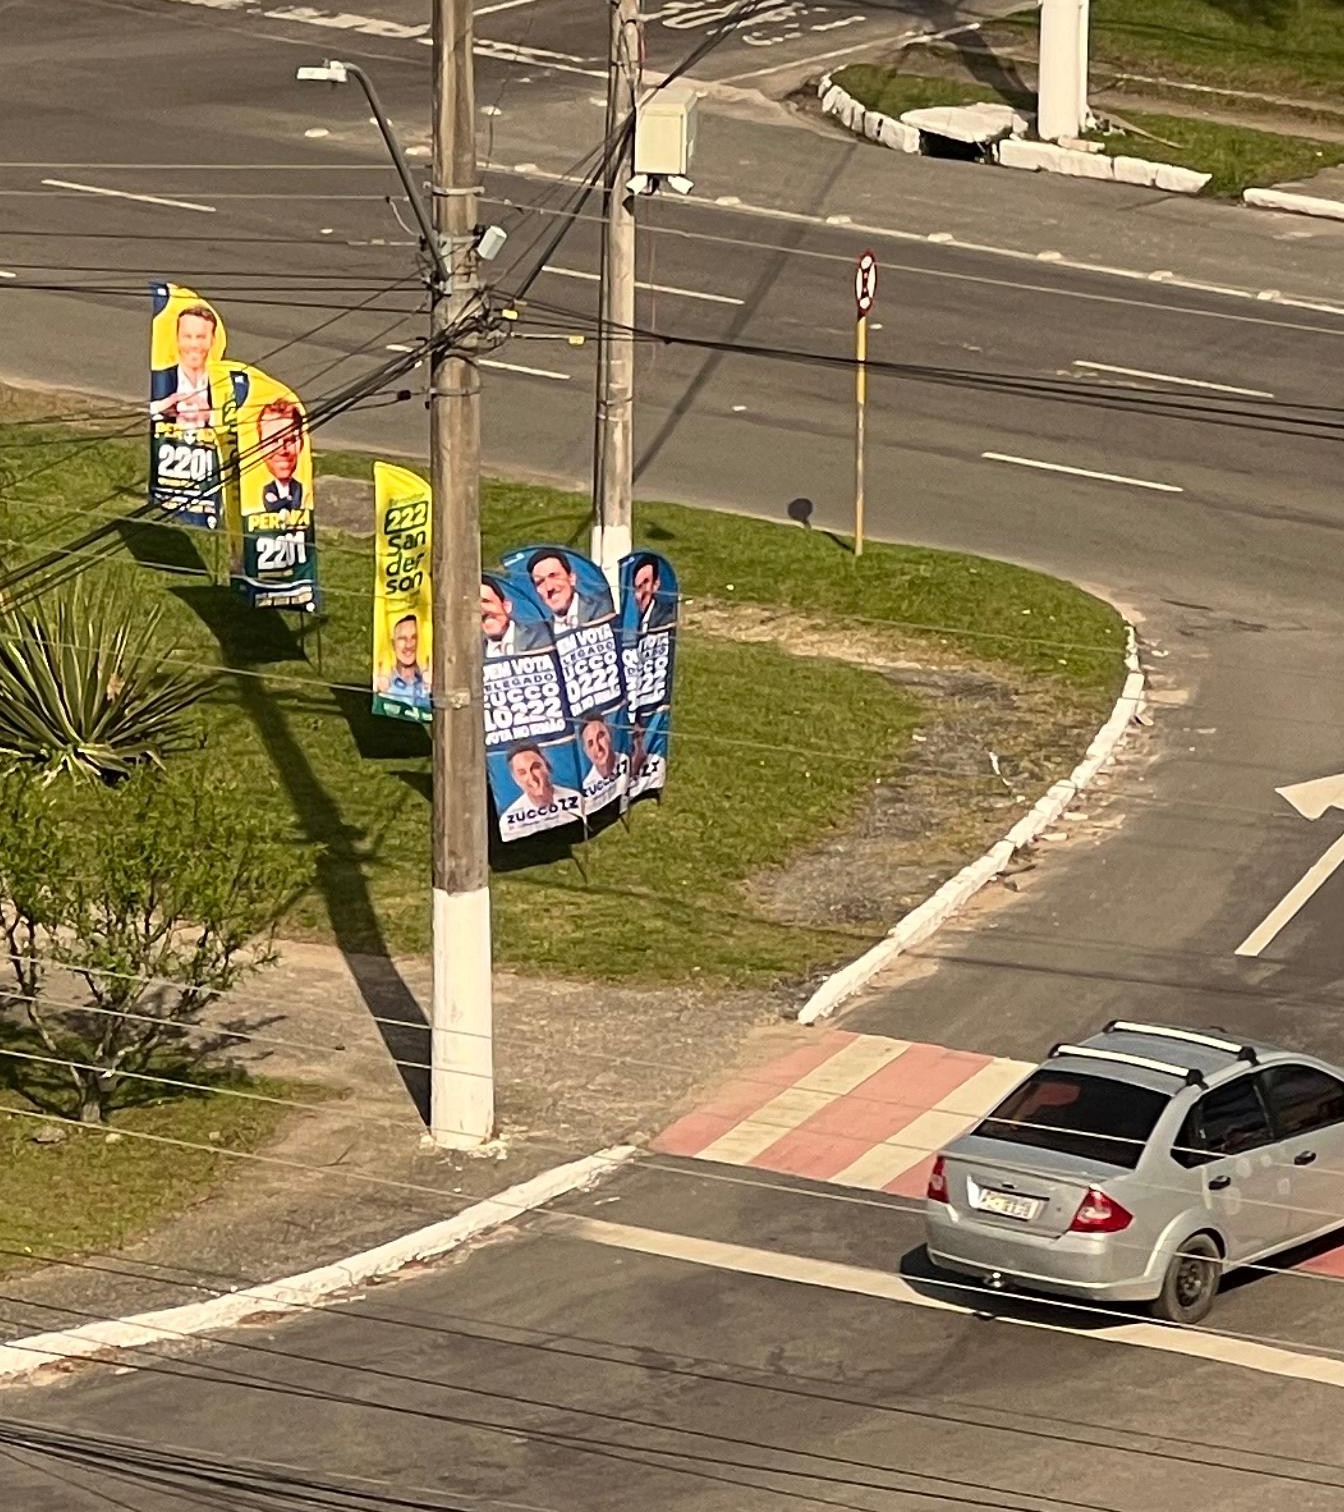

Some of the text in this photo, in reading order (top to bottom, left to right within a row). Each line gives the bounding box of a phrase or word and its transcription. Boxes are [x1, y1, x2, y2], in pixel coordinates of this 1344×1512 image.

[387, 501, 426, 533] 222
[388, 531, 426, 557] San
[386, 552, 424, 577] der
[386, 571, 423, 595] son
[576, 623, 614, 646] VOTA
[511, 654, 554, 675] VOTA
[484, 673, 554, 692] ELEGADO
[566, 664, 619, 704] 0222
[507, 803, 558, 824] ZUCCO
